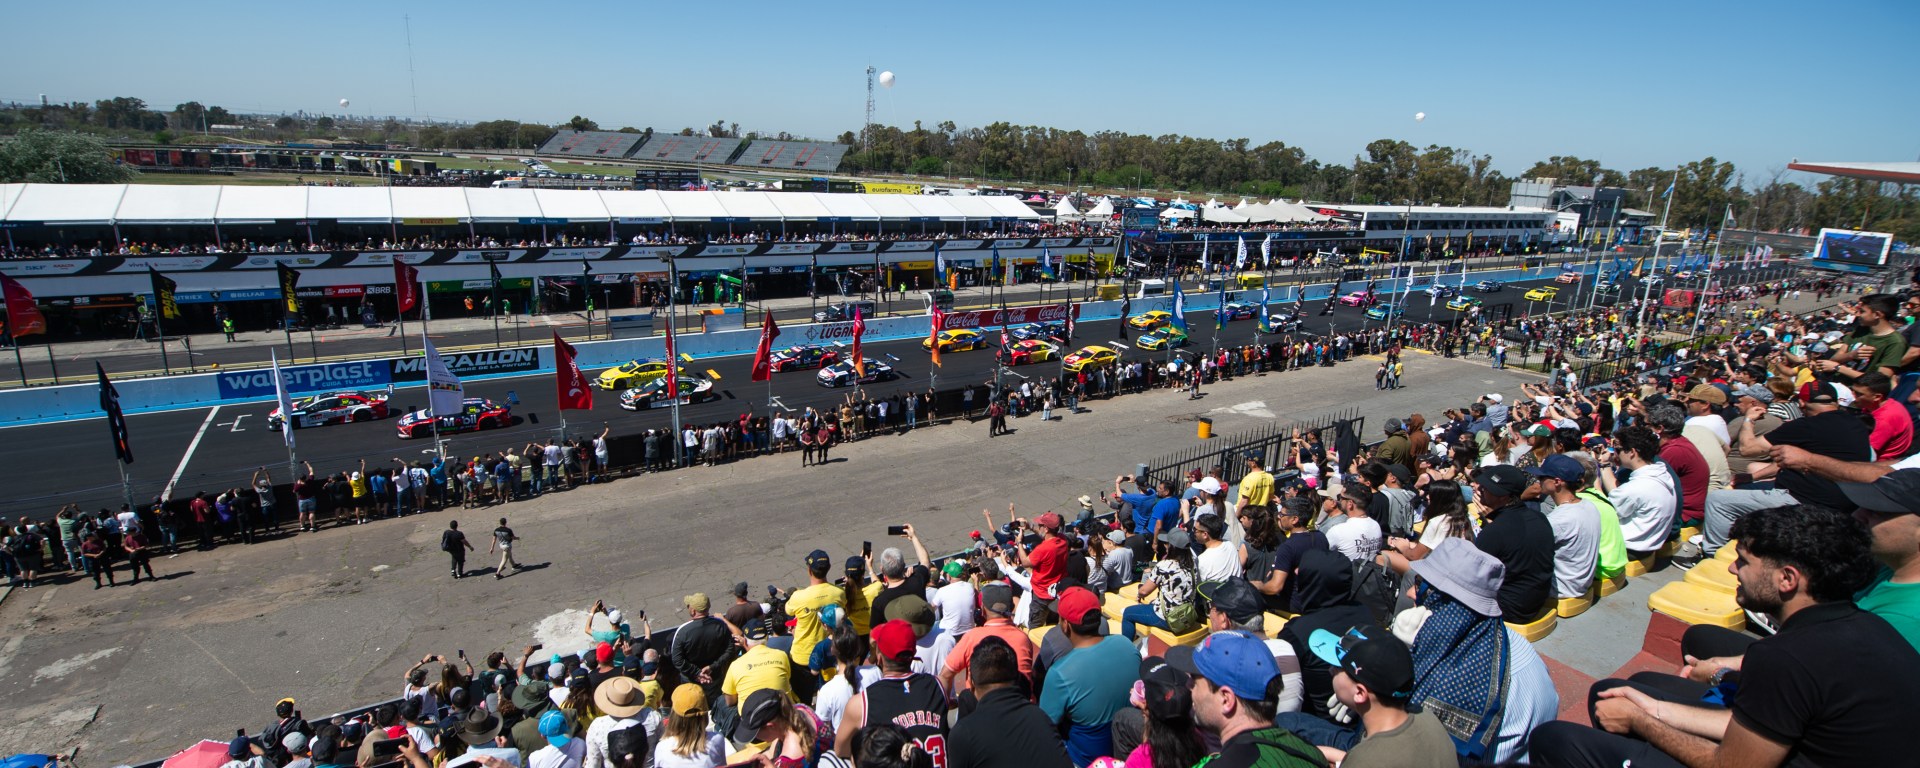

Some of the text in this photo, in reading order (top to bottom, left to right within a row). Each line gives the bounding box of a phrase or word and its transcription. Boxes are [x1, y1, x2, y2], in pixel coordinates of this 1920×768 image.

[321, 380, 342, 388] CUIDA
[443, 414, 477, 427] Mobil
[753, 660, 783, 668] eurofarma
